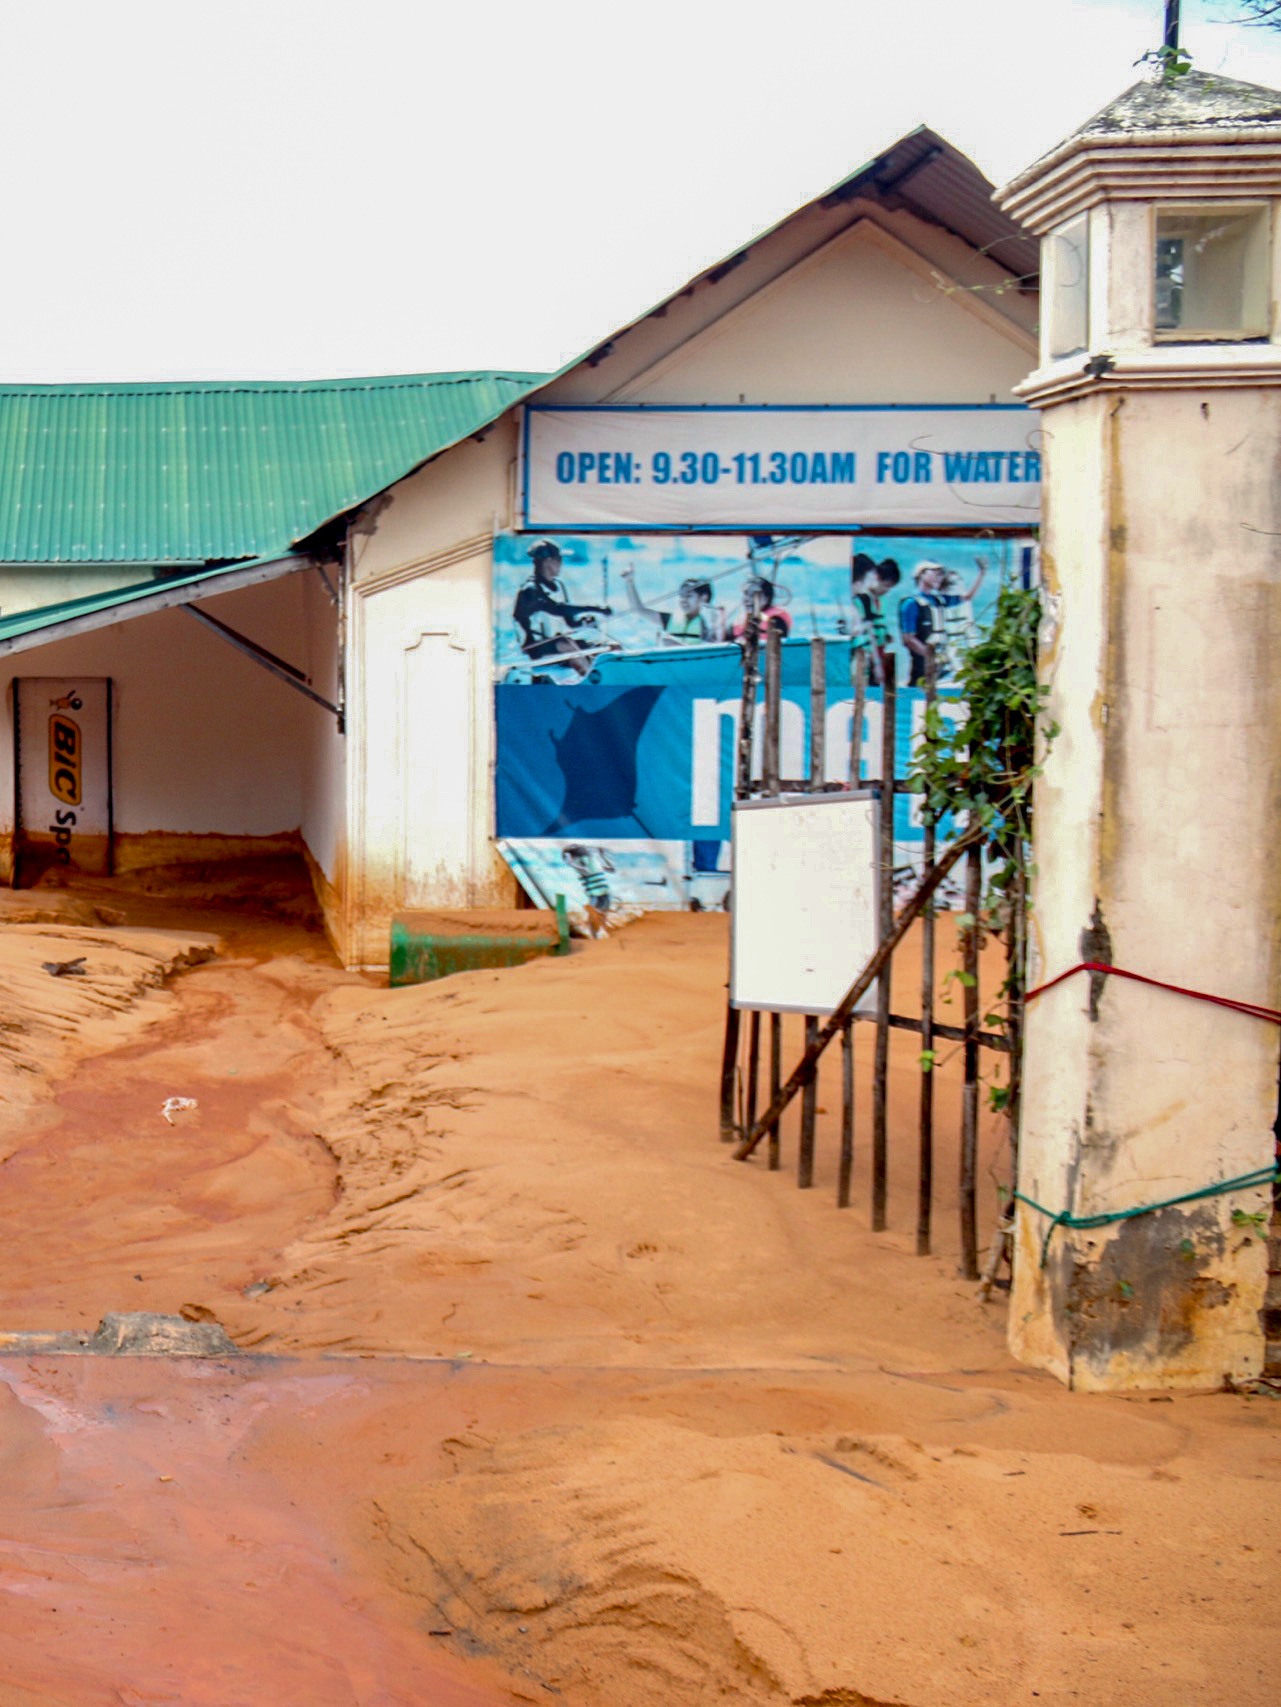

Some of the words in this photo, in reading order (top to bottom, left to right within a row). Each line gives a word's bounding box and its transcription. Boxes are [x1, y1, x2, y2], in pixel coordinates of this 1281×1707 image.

[556, 451, 641, 484] OPEN:
[652, 451, 855, 484] 9.30-11.30AM
[877, 451, 931, 484] FOR
[944, 451, 1041, 483] WATER
[54, 720, 77, 800] BIC
